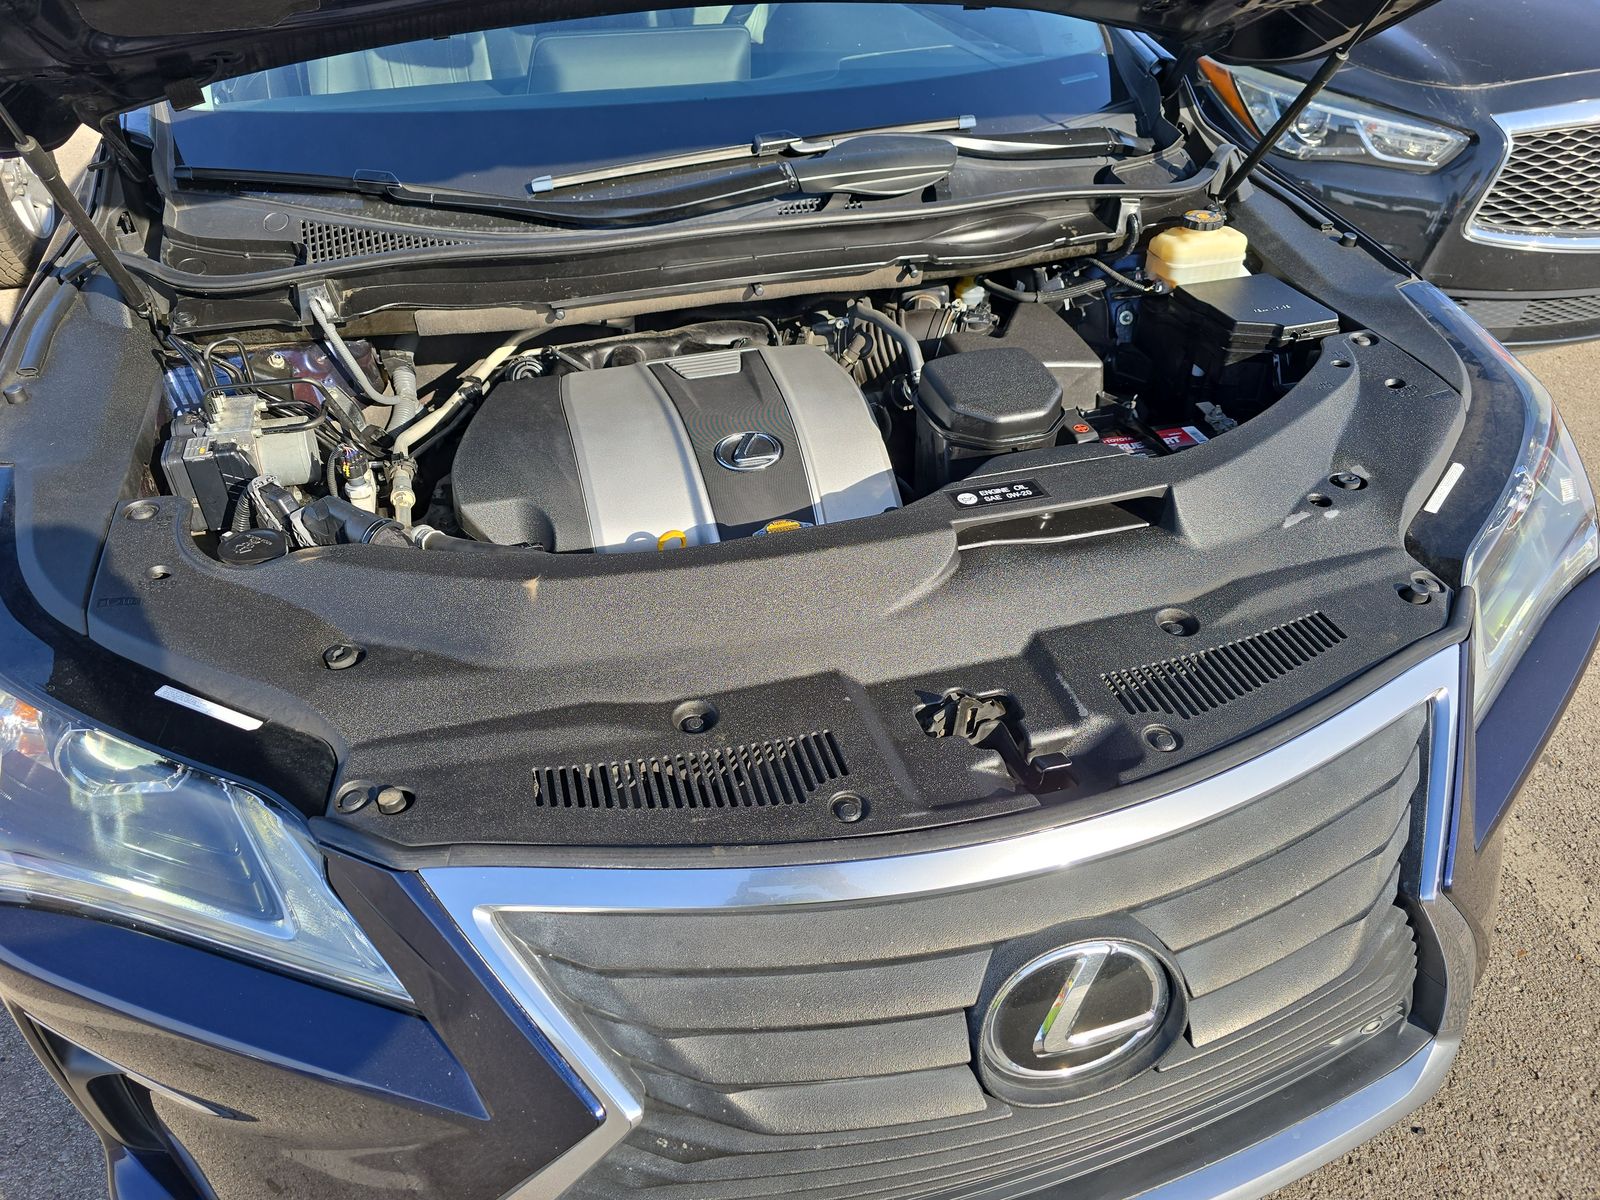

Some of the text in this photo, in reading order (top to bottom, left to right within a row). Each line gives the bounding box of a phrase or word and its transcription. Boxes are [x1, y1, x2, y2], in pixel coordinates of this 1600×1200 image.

[979, 486, 1011, 497] ENGINE
[984, 490, 1033, 502] SAE 0W-20
